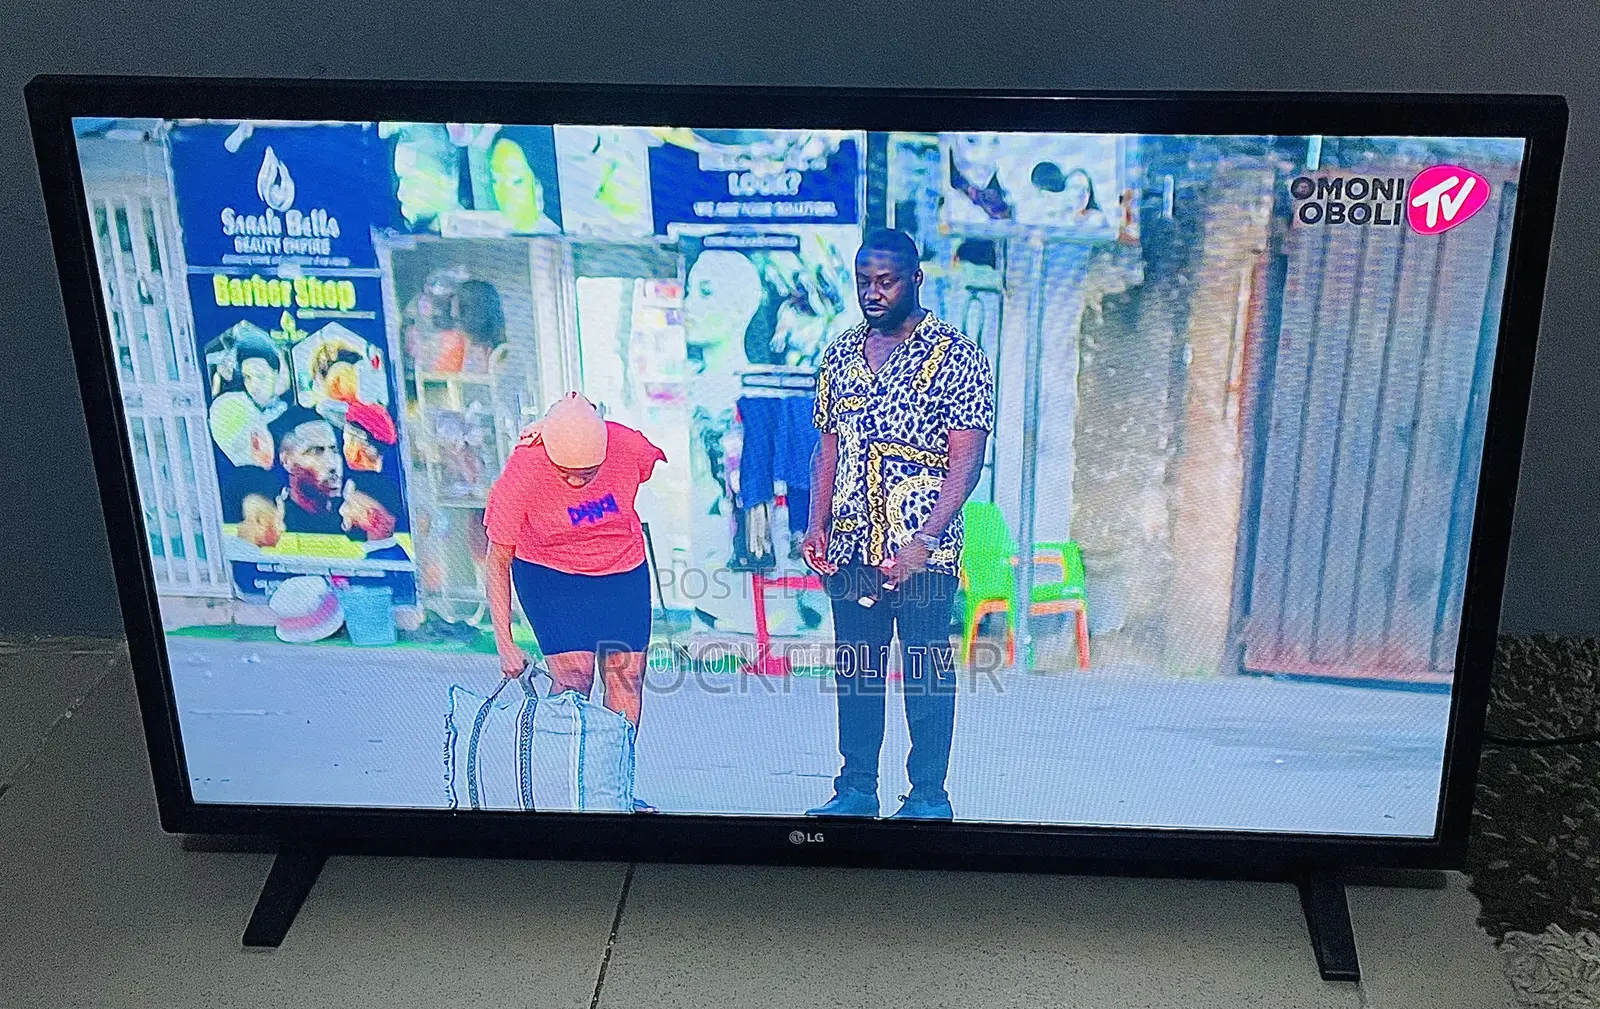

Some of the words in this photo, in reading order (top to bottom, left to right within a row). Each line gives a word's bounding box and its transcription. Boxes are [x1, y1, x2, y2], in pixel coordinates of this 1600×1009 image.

[1290, 176, 1405, 201] OMONI
[1298, 201, 1402, 226] OBOLI
[1411, 176, 1477, 228] TV
[234, 236, 282, 254] BEAUTY
[293, 275, 357, 312] Shop
[650, 639, 767, 676] OMONI
[784, 643, 893, 679] OBOLI
[907, 646, 956, 680] TV
[807, 832, 825, 843] LG
